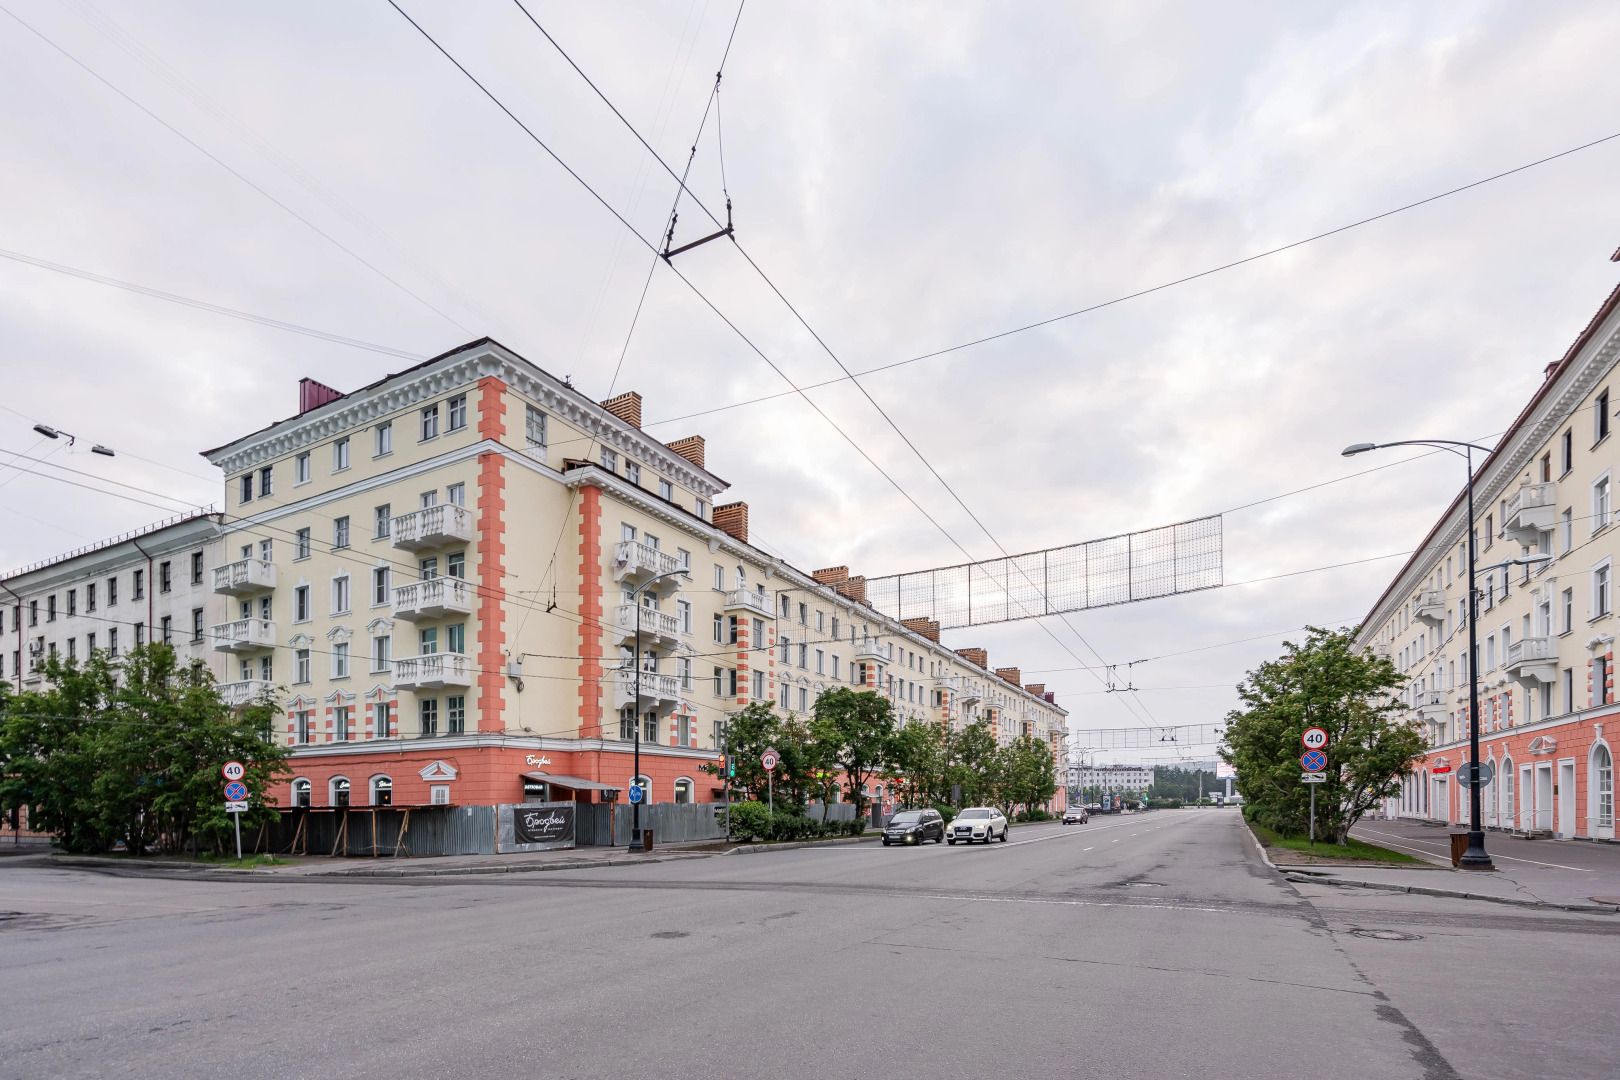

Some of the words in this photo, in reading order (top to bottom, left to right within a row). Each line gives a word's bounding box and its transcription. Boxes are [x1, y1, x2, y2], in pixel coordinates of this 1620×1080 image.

[1307, 734, 1323, 744] 40
[227, 766, 241, 775] 40
[524, 811, 565, 833] Бродвей
